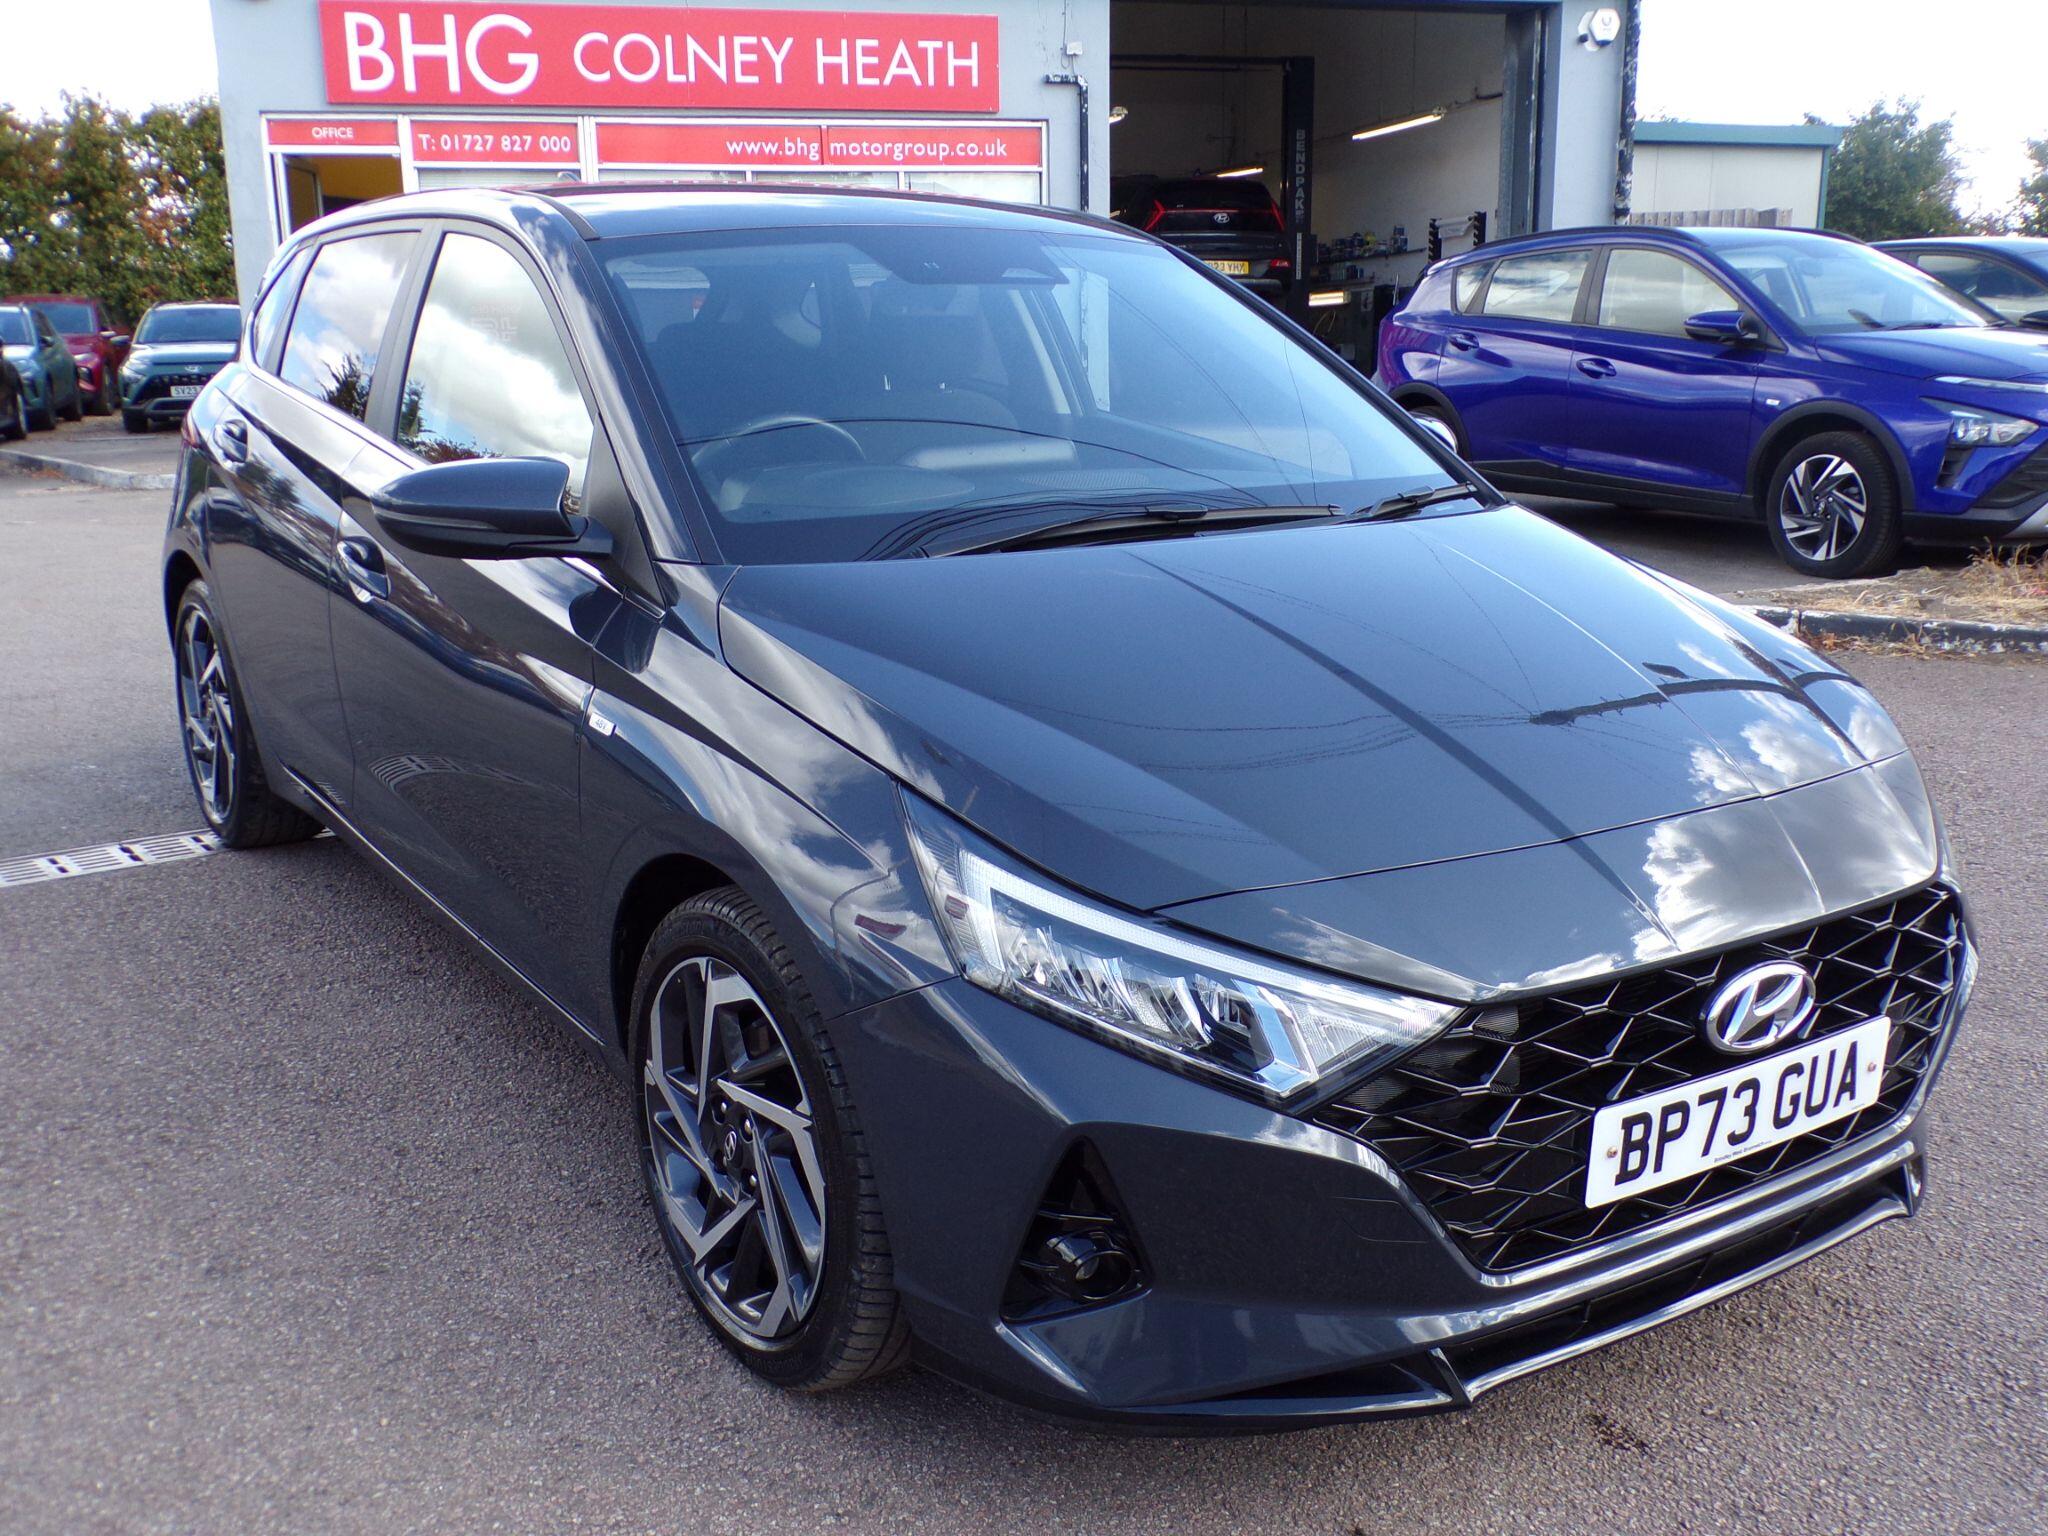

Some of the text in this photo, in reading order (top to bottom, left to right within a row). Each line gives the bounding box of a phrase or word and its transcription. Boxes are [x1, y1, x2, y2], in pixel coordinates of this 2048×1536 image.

[344, 12, 979, 95] BHG COLNEY HEATH
[312, 126, 354, 139] OFFICE
[418, 133, 571, 152] T: 01727 827 000
[1614, 1040, 1858, 1186] BP73 GUA
